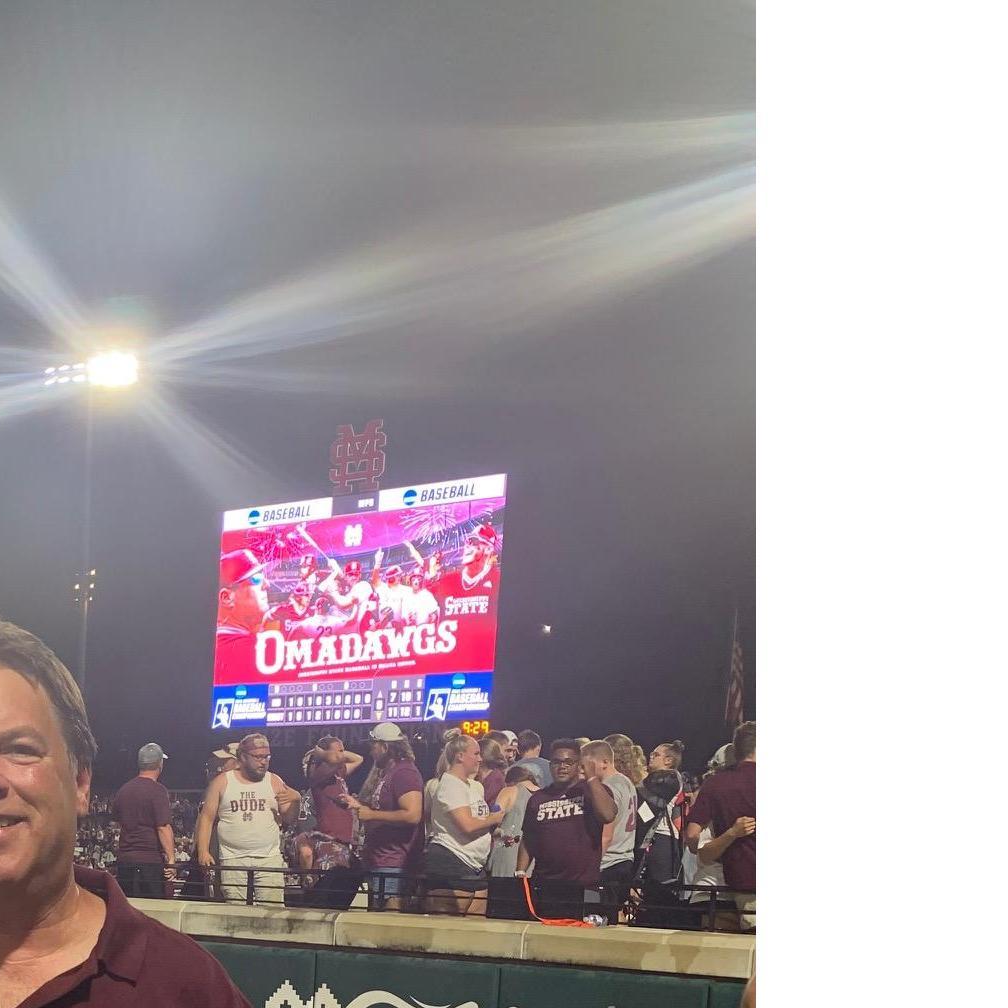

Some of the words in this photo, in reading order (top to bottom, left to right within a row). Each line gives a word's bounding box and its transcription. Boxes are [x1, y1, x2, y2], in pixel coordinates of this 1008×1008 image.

[420, 483, 476, 503] BASEBALL
[262, 504, 311, 522] BASEBALL
[254, 619, 458, 675] OMADAWGS
[462, 721, 490, 735] 9:29
[240, 791, 257, 800] THE
[230, 799, 266, 813] DUDE
[536, 803, 584, 822] STATE
